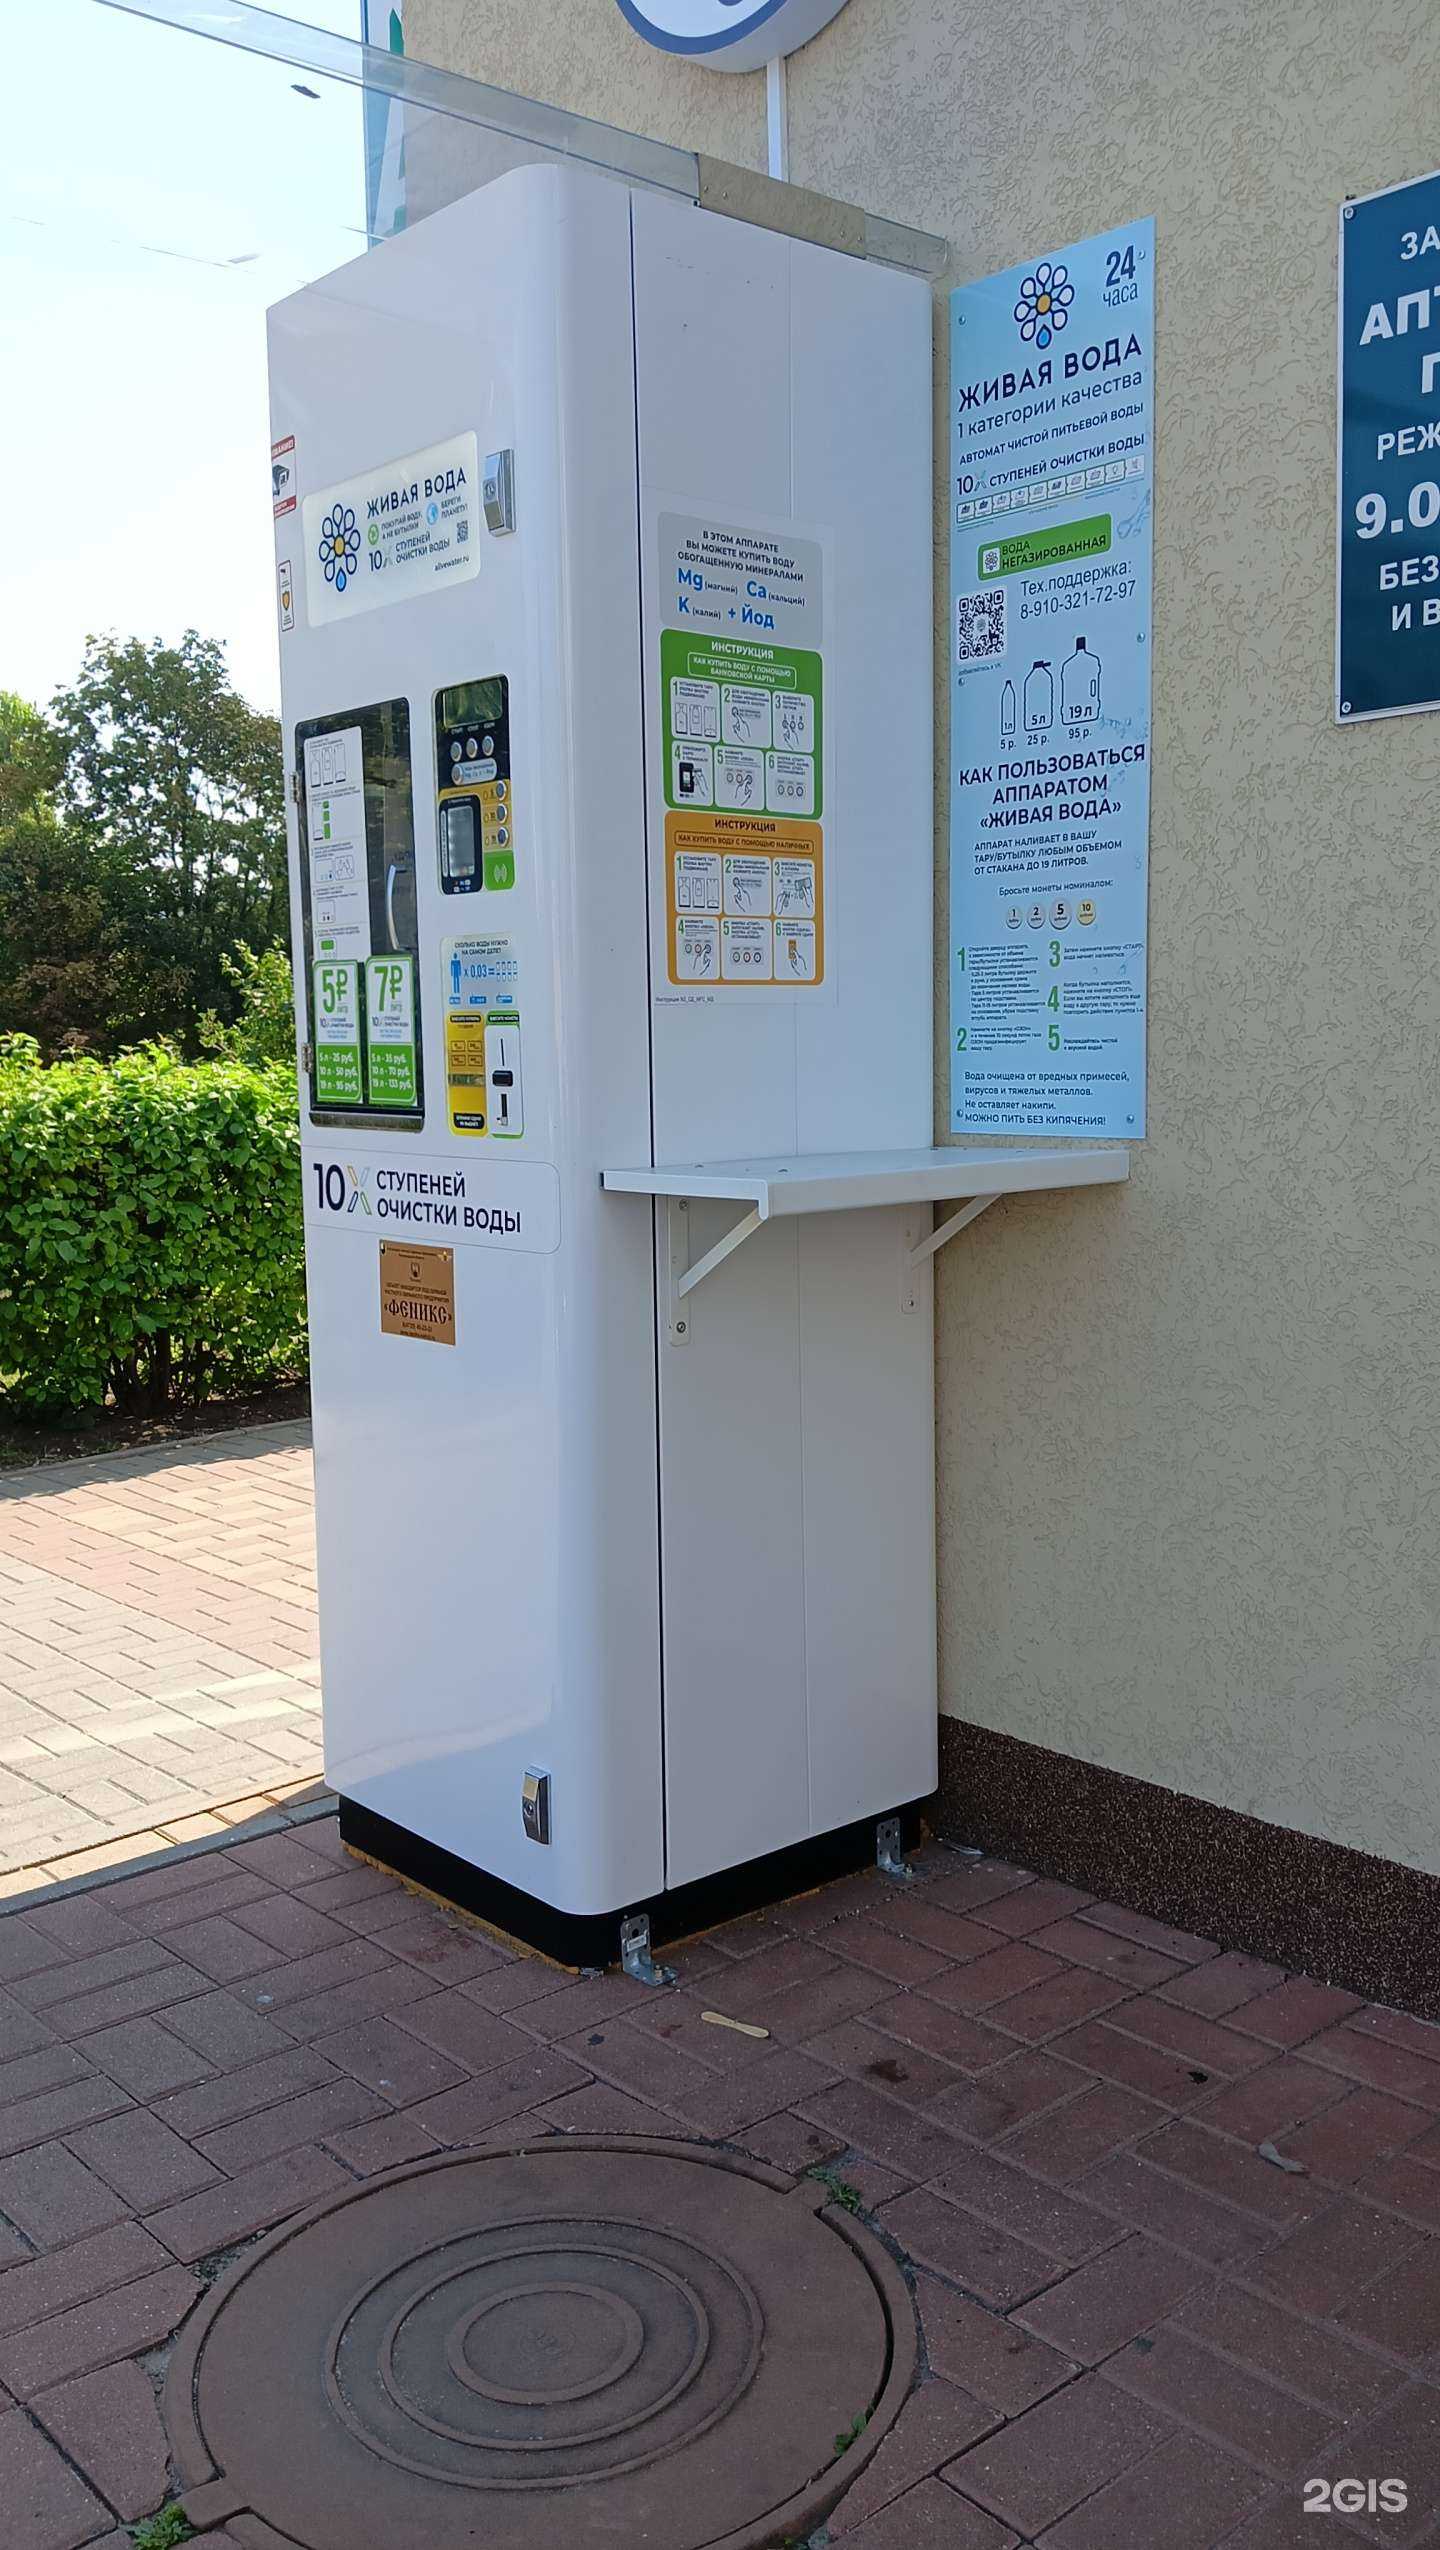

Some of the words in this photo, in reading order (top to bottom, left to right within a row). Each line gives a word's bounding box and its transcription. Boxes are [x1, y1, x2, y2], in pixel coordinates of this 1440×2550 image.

[1106, 245, 1135, 287] 24
[1103, 282, 1138, 308] часа
[1360, 285, 1440, 345] АП
[958, 360, 1052, 412] ЖИВАЯ
[1065, 333, 1142, 379] ВОДА
[958, 422, 963, 438] 1
[969, 398, 1056, 437] категории
[1062, 371, 1142, 408] качества
[959, 444, 1005, 465] АВТОМАТ
[1007, 429, 1049, 451] ЧИСТОЙ
[1052, 413, 1108, 438] ПИТЬЕВОЙ
[1111, 403, 1143, 420] ВОДЫ
[990, 461, 1046, 488] СТУПЕНЕЙ
[1050, 447, 1104, 469] ОЧИСТКИ
[1109, 433, 1144, 454] ВОДЫ
[367, 483, 418, 519] ЖИВАЯ
[424, 467, 466, 497] ВОДА
[396, 531, 430, 552] СТУПЕНЕЙ
[396, 546, 427, 563] ОЧИСТКИ
[430, 539, 450, 553] ВОДЫ
[703, 531, 708, 539] В
[711, 532, 733, 544] ЭТОМ
[736, 538, 778, 553] АППАРАТЕ
[1002, 540, 1030, 556] ВОДА
[1002, 534, 1106, 570] НЕГАЗИРОВАННАЯ
[687, 540, 699, 550] ВЫ
[702, 543, 737, 558] МОЖЕТЕ
[739, 551, 770, 564] КУПИТЬ
[773, 558, 795, 569] ВОДУ
[678, 552, 743, 571] ОБОГАЩЕННУЮ
[746, 565, 804, 582] МИНЕРАЛАМИ
[1380, 555, 1439, 590] БЕЗ
[678, 568, 703, 591] Mg
[1021, 560, 1132, 596] Тех.поддержка:
[1020, 580, 1136, 620] 8-910-321-72-97
[742, 604, 774, 630] Йод
[1392, 603, 1411, 631] И
[712, 641, 774, 660] ИНСТРУКЦИЯ
[673, 681, 678, 696] 1
[724, 688, 730, 703] 2
[775, 695, 781, 709] 3
[1069, 706, 1082, 719] 19
[1027, 736, 1038, 745] 25
[1069, 728, 1081, 739] 95
[1000, 740, 1005, 749] 5
[717, 749, 723, 764] 5
[768, 755, 774, 769] 6
[960, 767, 992, 785] КАК
[998, 744, 1145, 780] ПОЛЬЗОВАТЬСЯ
[993, 774, 1107, 804] АППАРАТОМ
[980, 806, 1052, 828] «ЖИВАЯ
[1059, 798, 1121, 819] ВОДА»
[715, 819, 776, 832] ИНСТРУКЦИЯ
[975, 840, 1013, 851] АППАРАТ
[1015, 835, 1060, 846] НАЛИВАЕТ
[1071, 831, 1097, 841] ВАШУ
[975, 850, 1035, 863] ТАРУ/БУТЫЛКУ
[1038, 846, 1073, 857] ЛЮБЫМ
[1076, 841, 1122, 852] ОБЪЕМОМ
[677, 856, 682, 870] 1
[725, 859, 732, 873] 2
[774, 862, 780, 876] 3
[975, 866, 984, 875] ОТ
[987, 862, 1024, 874] СТАКАНА
[1027, 861, 1039, 871] ДО
[1042, 860, 1049, 868] 19
[1051, 857, 1088, 868] ЛИТРОВ.
[999, 886, 1029, 896] Бросьте
[1032, 884, 1062, 893] монеты
[1064, 880, 1113, 891] номиналом:
[1012, 909, 1016, 917] 1
[1034, 907, 1039, 915] 2
[1057, 903, 1064, 915] 5
[678, 920, 684, 934] 4
[723, 921, 729, 935] 5
[776, 922, 781, 936] 6
[958, 947, 965, 971] 1
[1049, 940, 1061, 967] 3
[471, 964, 487, 979] 0,03
[1047, 985, 1060, 1012] 4
[957, 1027, 967, 1051] 2
[1048, 1024, 1060, 1051] 5
[965, 1072, 985, 1080] Вода
[987, 1073, 1024, 1081] очищена
[1039, 1073, 1077, 1081] вредных
[1081, 1072, 1129, 1082] примесей,
[965, 1087, 998, 1095] вирусов
[1048, 1088, 1093, 1096] металлов.
[965, 1100, 976, 1108] Не
[965, 1114, 999, 1122] МОЖНО
[1002, 1115, 1024, 1123] ПИТЬ
[1027, 1115, 1043, 1124] БЕЗ
[1046, 1116, 1106, 1125] КИПЯЧЕНИЯ!
[377, 1170, 466, 1198] СТУПЕНЕЙ
[377, 1198, 457, 1226] ОЧИСТКИ
[464, 1207, 521, 1234] ВОДЫ
